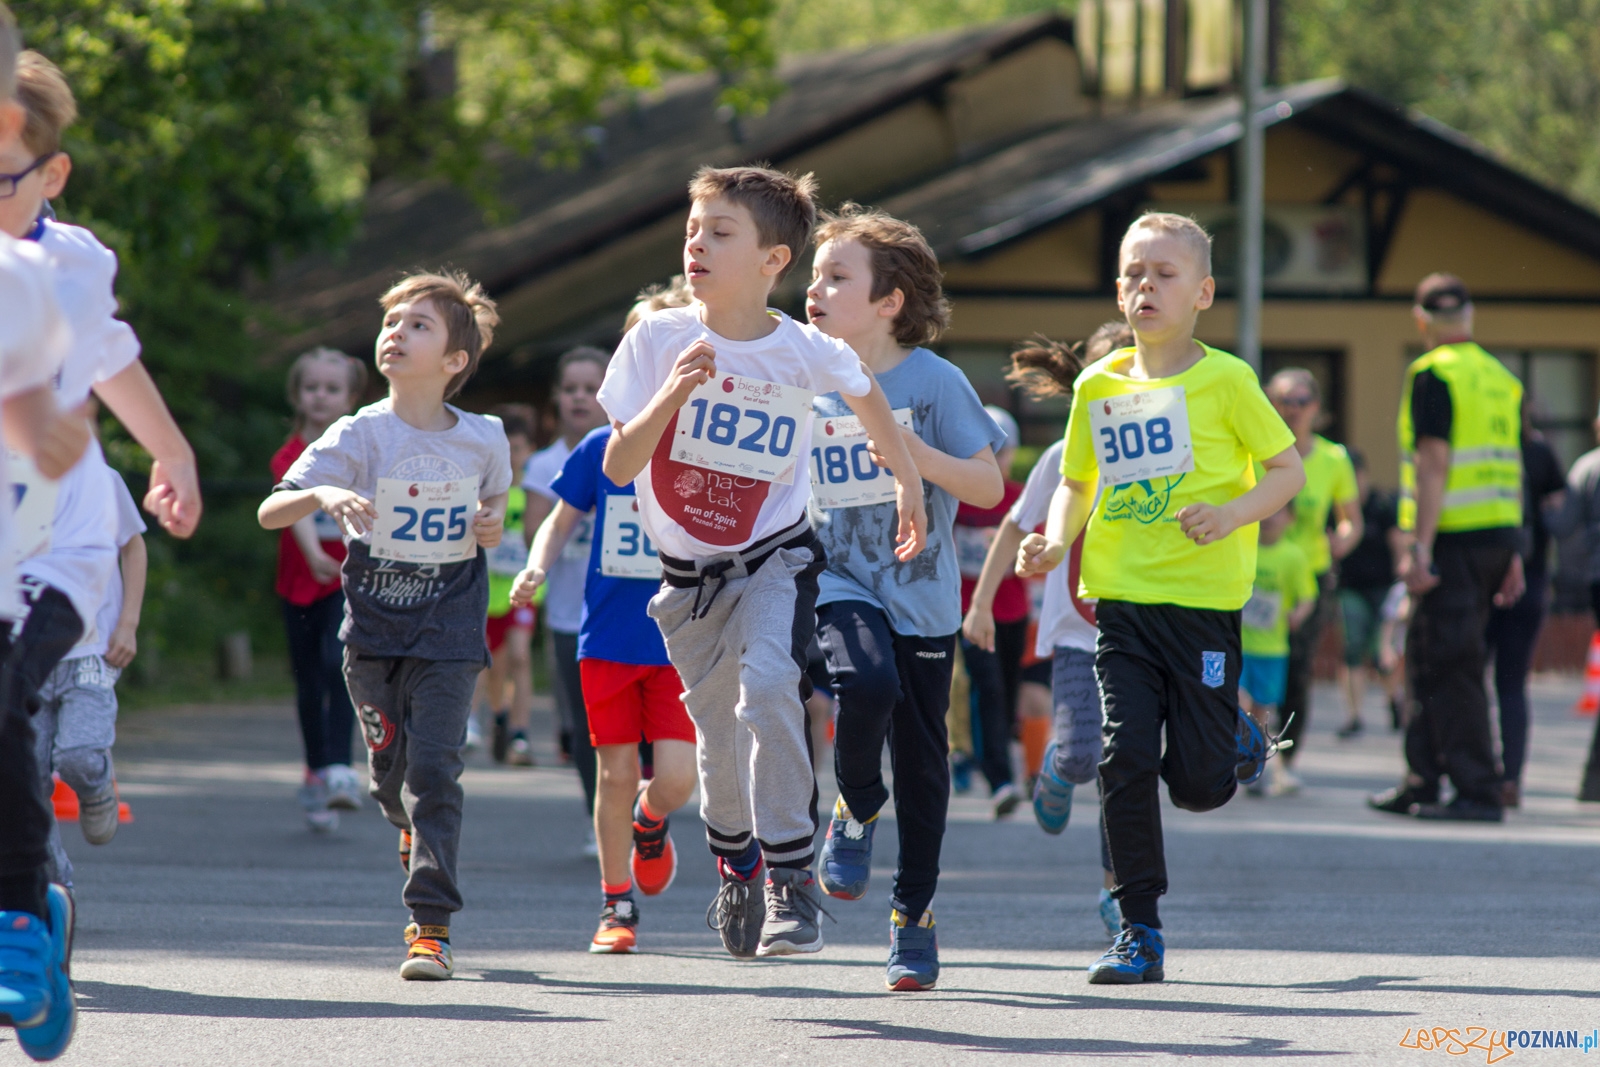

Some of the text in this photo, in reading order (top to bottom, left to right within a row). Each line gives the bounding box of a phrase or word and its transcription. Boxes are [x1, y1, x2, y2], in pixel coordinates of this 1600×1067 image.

[738, 378, 761, 397] bieg
[691, 398, 796, 458] 1820
[1100, 417, 1174, 464] 308
[811, 443, 893, 485] 180
[707, 473, 733, 490] na
[706, 487, 742, 512] tak
[391, 505, 467, 542] 265
[683, 504, 737, 528] Run of Spirit
[713, 523, 727, 533] 2017
